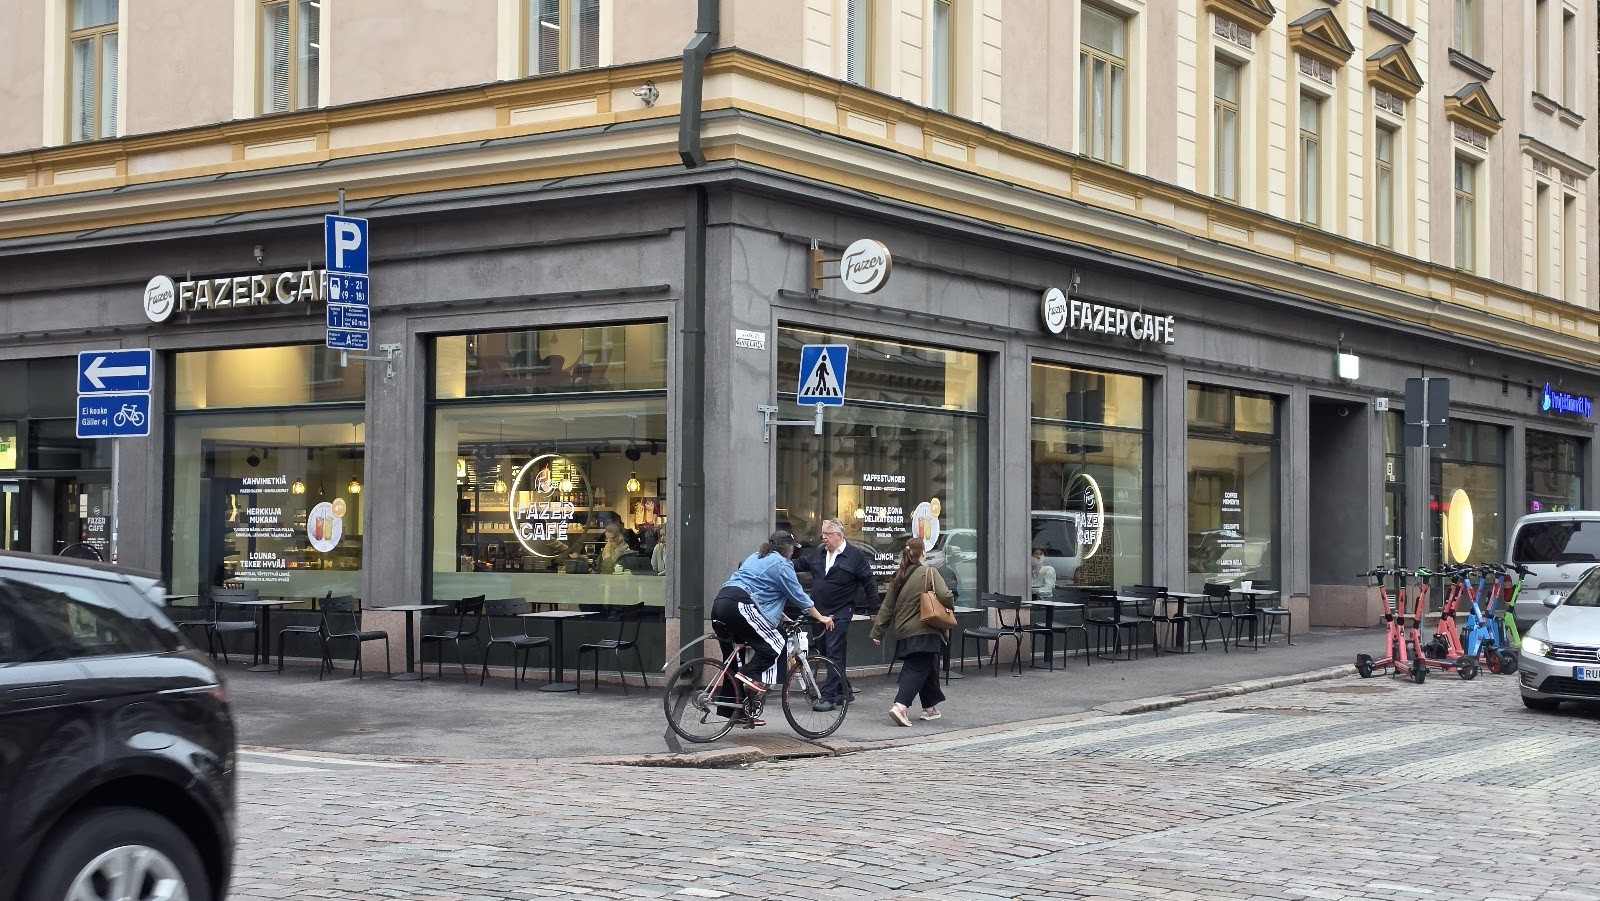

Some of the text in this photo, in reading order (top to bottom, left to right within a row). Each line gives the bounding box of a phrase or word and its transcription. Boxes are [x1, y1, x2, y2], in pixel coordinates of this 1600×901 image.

[334, 220, 362, 269] P
[845, 248, 884, 281] Fazer
[344, 279, 349, 289] 9
[355, 280, 363, 290] 21
[147, 283, 174, 312] Fazer
[179, 274, 271, 312] FAZER
[341, 290, 349, 300] (9
[1047, 297, 1066, 321] Fazer
[1070, 299, 1175, 345] FAZER CAFÉ
[345, 333, 352, 345] A
[89, 406, 108, 415] koske
[81, 417, 108, 427] Gäller ej
[242, 475, 287, 486] KAHVIHETKIÄ
[863, 473, 906, 484] KAFFESTUNDER
[246, 507, 282, 516] HERKKUJA
[516, 501, 575, 520] FAZER
[249, 516, 278, 524] MUKAAN
[519, 520, 568, 541] CAFÉ
[249, 552, 277, 560] LOUNAS
[874, 552, 894, 561] LUNCH
[240, 558, 286, 569] TEKEE HYVÄÄ
[1585, 669, 1600, 679] RU
